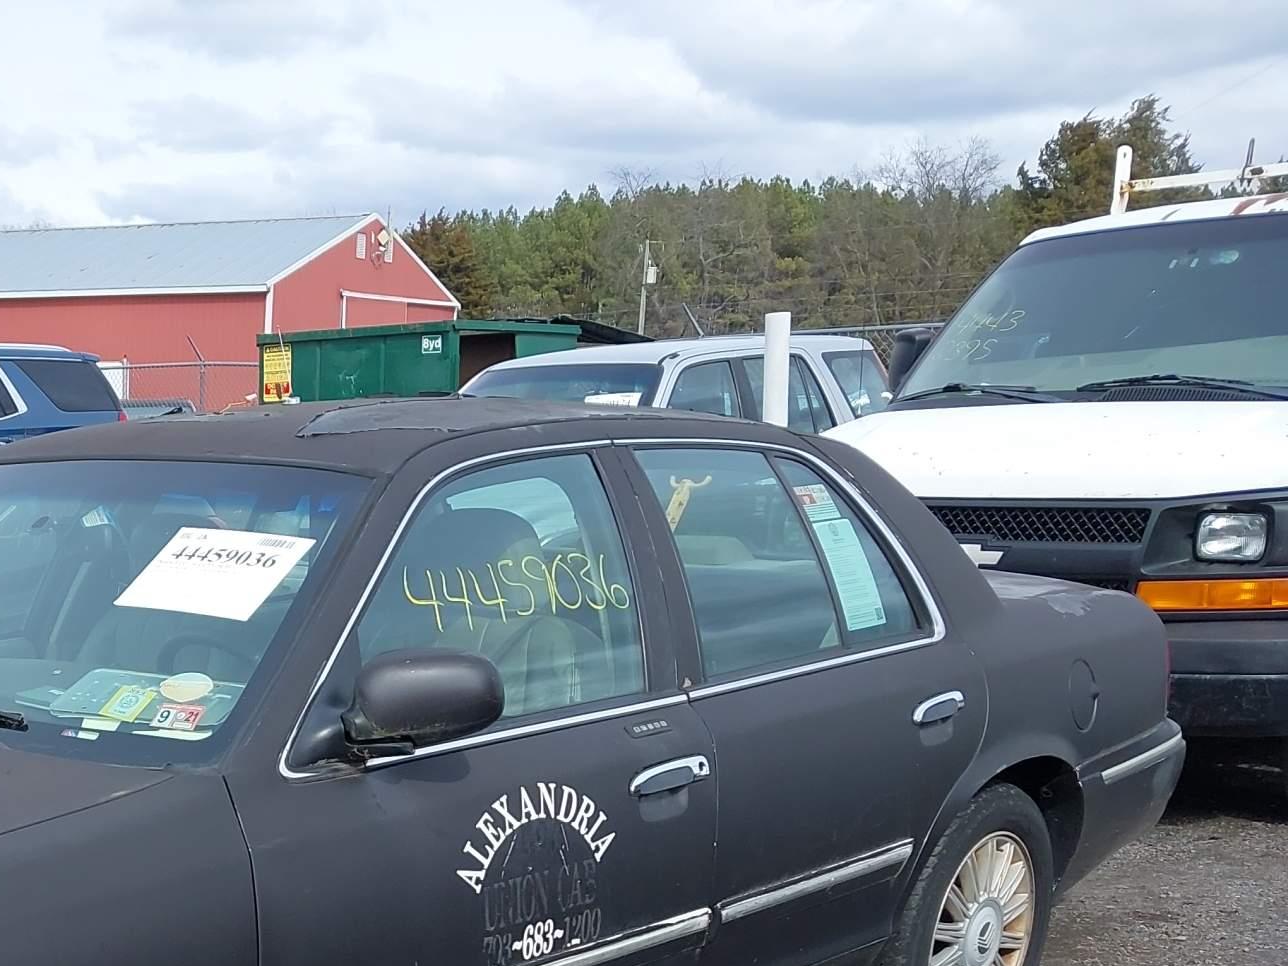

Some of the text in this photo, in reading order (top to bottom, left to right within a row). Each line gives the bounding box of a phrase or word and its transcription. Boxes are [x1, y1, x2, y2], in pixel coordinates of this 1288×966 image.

[171, 545, 281, 569] 44459036
[403, 553, 630, 633] 44459036
[158, 709, 199, 723] 9 21
[456, 782, 616, 895] ALEXANDRIA
